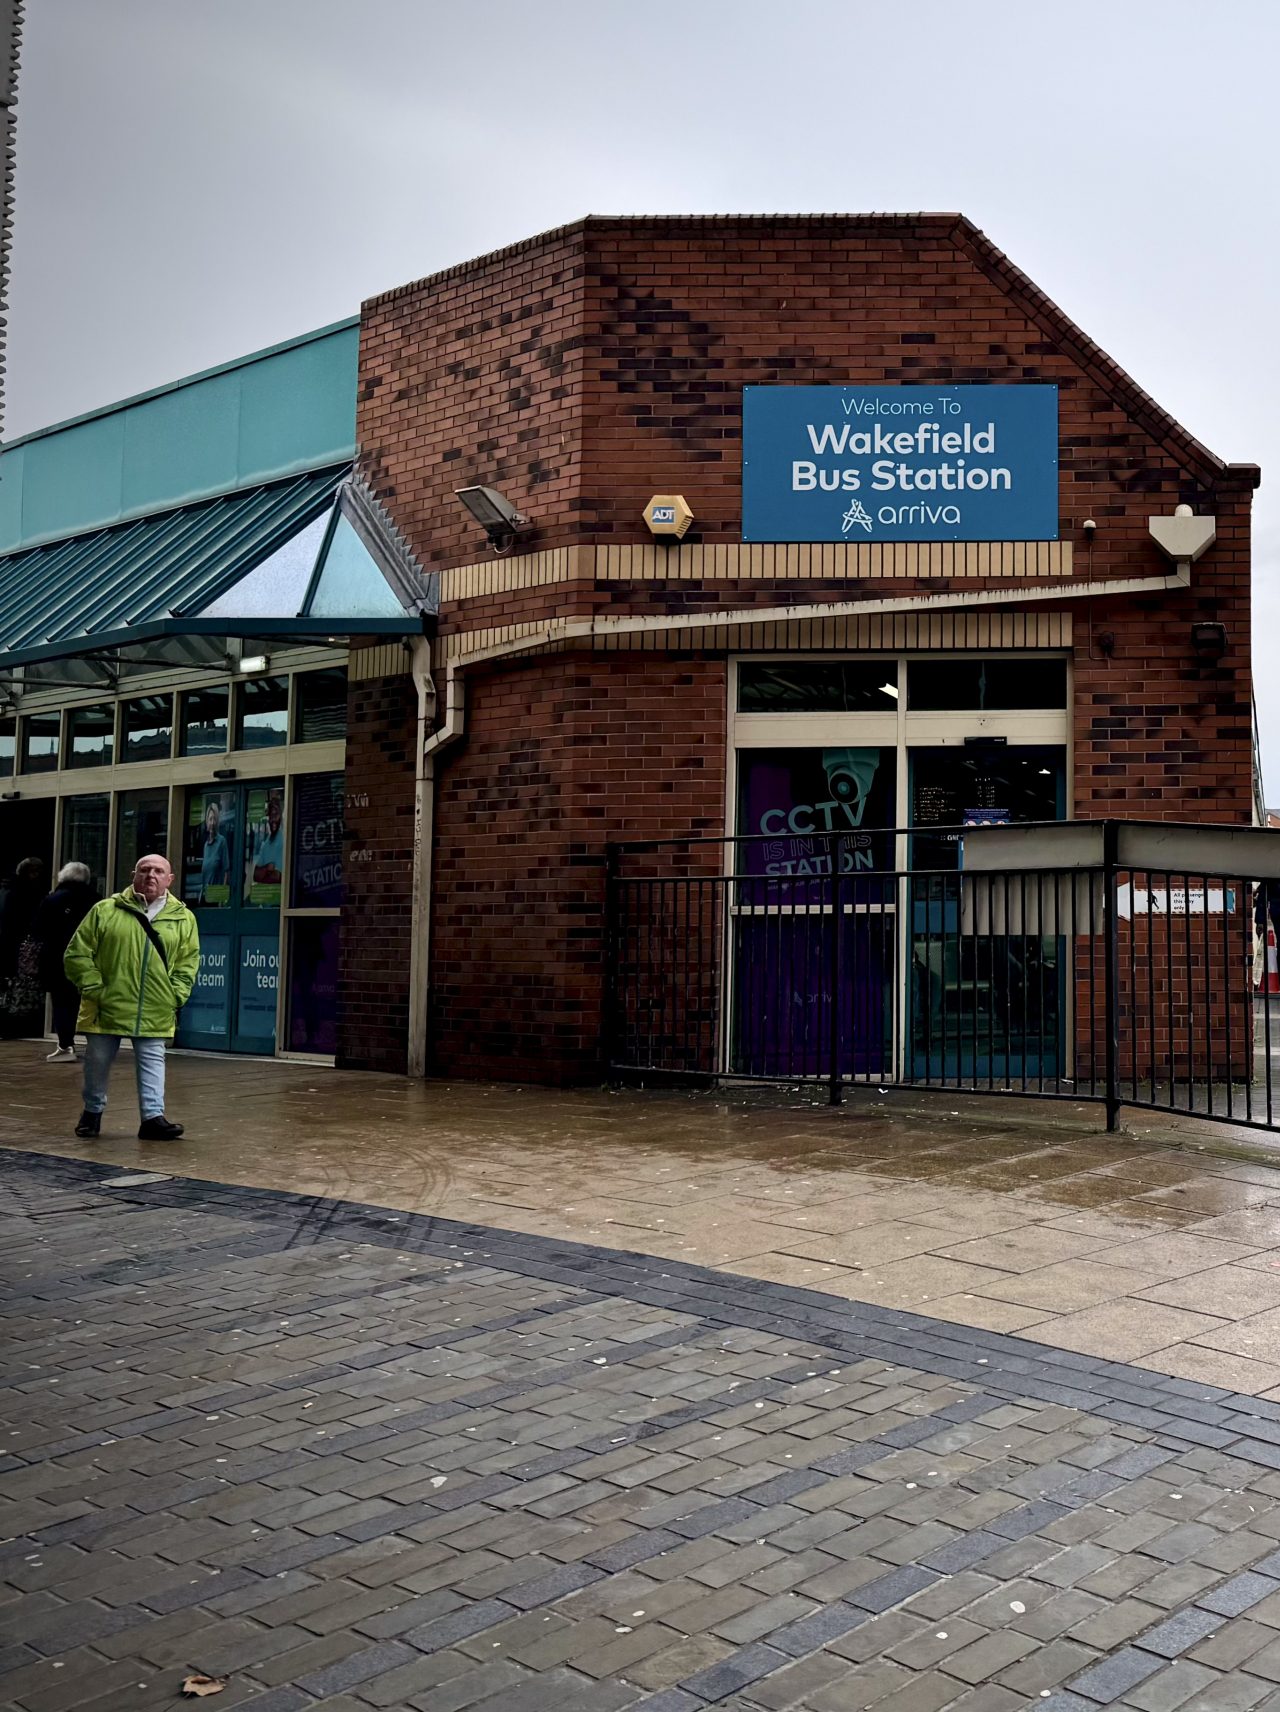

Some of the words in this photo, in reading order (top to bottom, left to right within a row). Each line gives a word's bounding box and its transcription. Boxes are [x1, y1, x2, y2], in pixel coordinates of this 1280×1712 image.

[841, 398, 934, 415] Welcome
[938, 397, 962, 415] To
[806, 422, 995, 455] Wakefield
[792, 460, 861, 491] Bus
[871, 459, 1012, 491] Station
[652, 509, 676, 520] ADT
[877, 500, 961, 524] arriva
[760, 796, 867, 835] CCTV
[303, 863, 343, 888] STATIO
[208, 953, 226, 967] our
[242, 949, 266, 968] Join
[268, 954, 279, 968] ou
[197, 971, 225, 987] team
